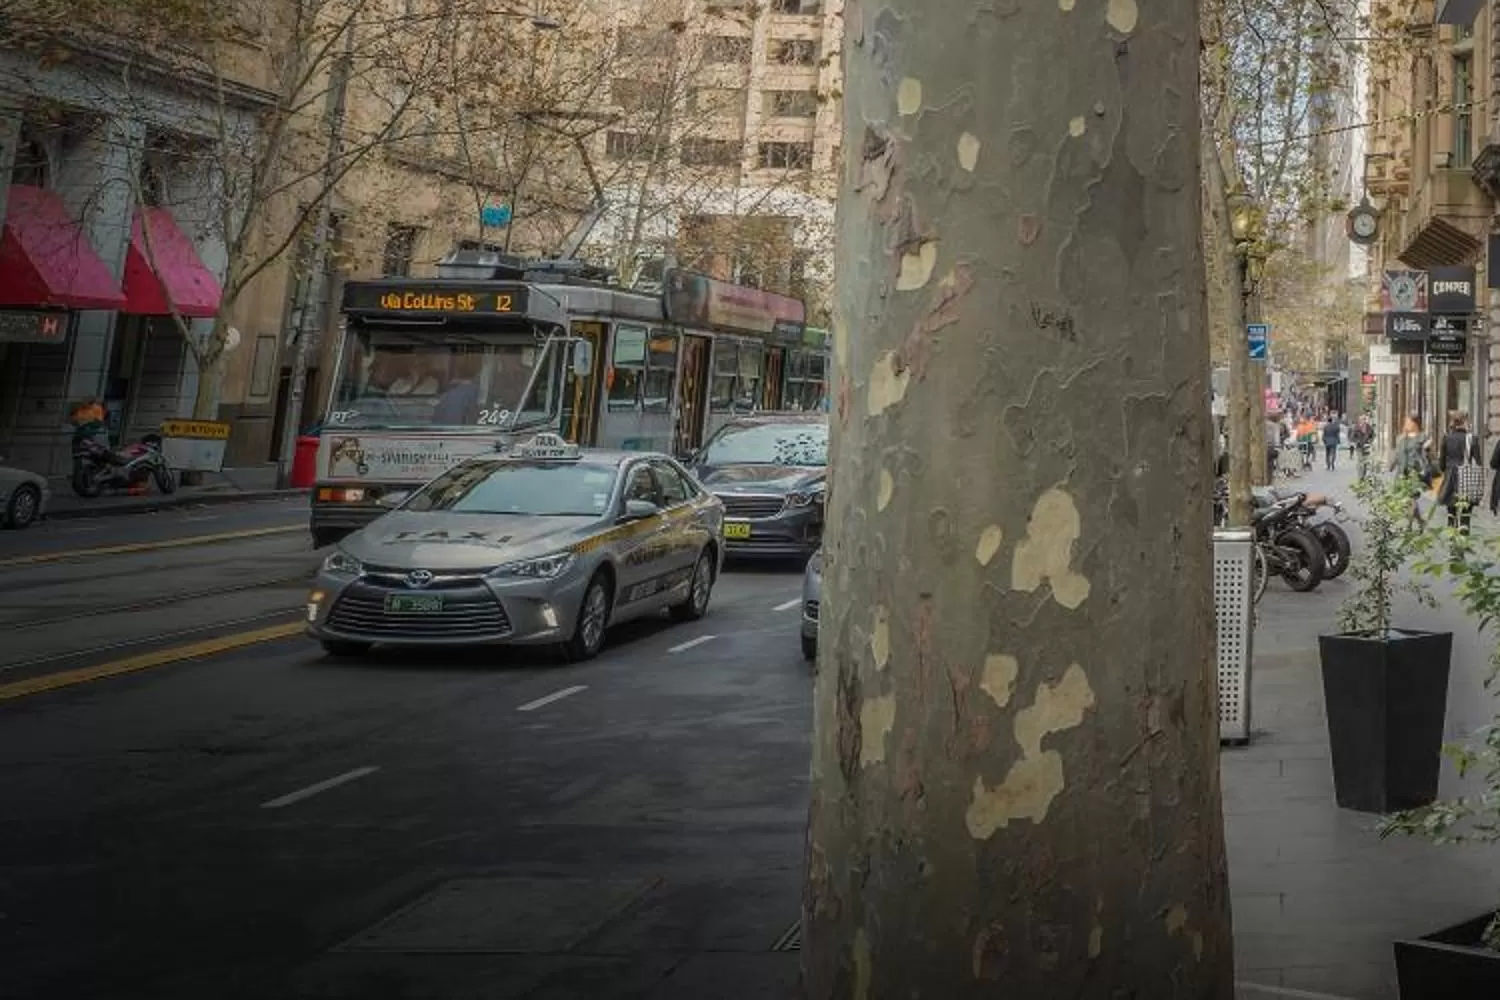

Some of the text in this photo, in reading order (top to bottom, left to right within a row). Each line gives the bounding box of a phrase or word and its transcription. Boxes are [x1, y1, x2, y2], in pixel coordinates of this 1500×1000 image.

[403, 292, 455, 311] Collins
[456, 292, 476, 312] St
[495, 295, 512, 312] 12
[478, 409, 510, 426] 249
